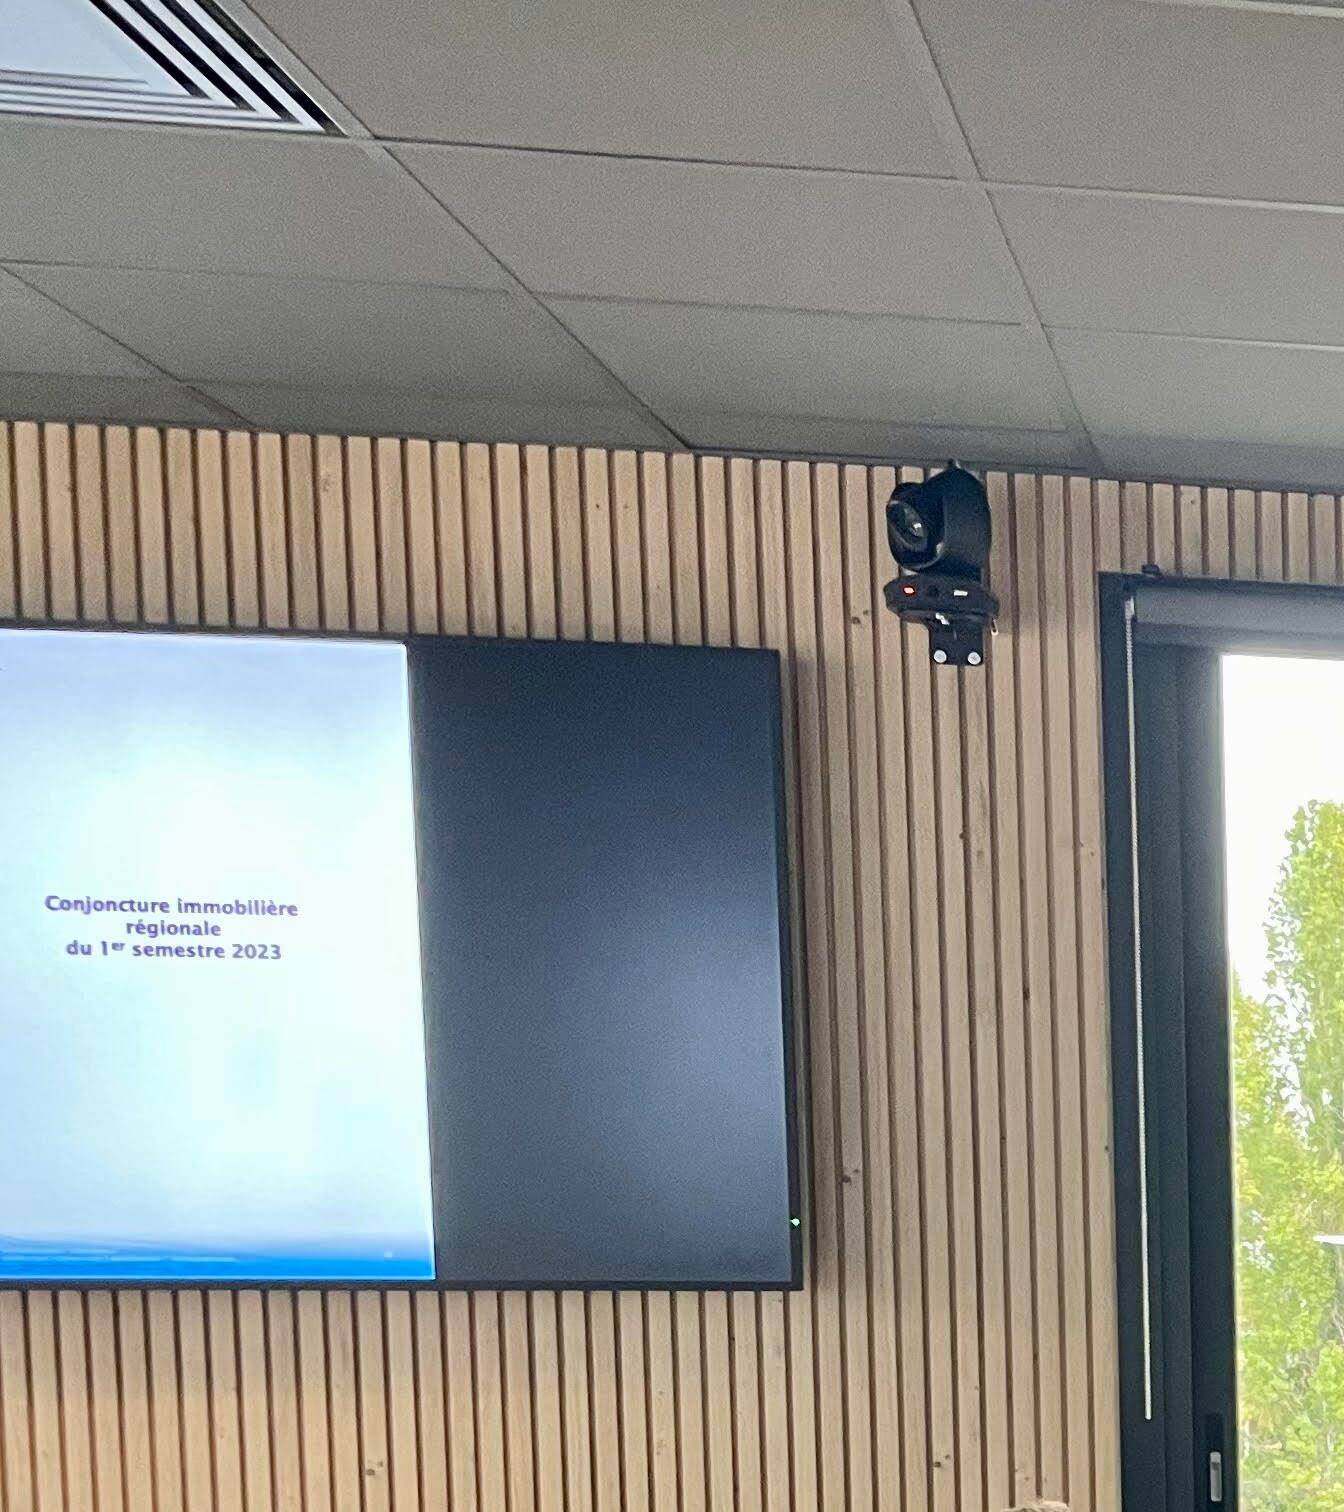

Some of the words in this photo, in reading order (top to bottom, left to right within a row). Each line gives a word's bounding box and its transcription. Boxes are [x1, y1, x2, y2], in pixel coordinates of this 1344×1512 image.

[44, 895, 171, 915] Conjoncture
[177, 897, 300, 916] immobilière
[126, 919, 222, 938] régionale
[65, 940, 93, 956] du
[132, 943, 226, 959] semestre
[232, 944, 283, 960] 2023
